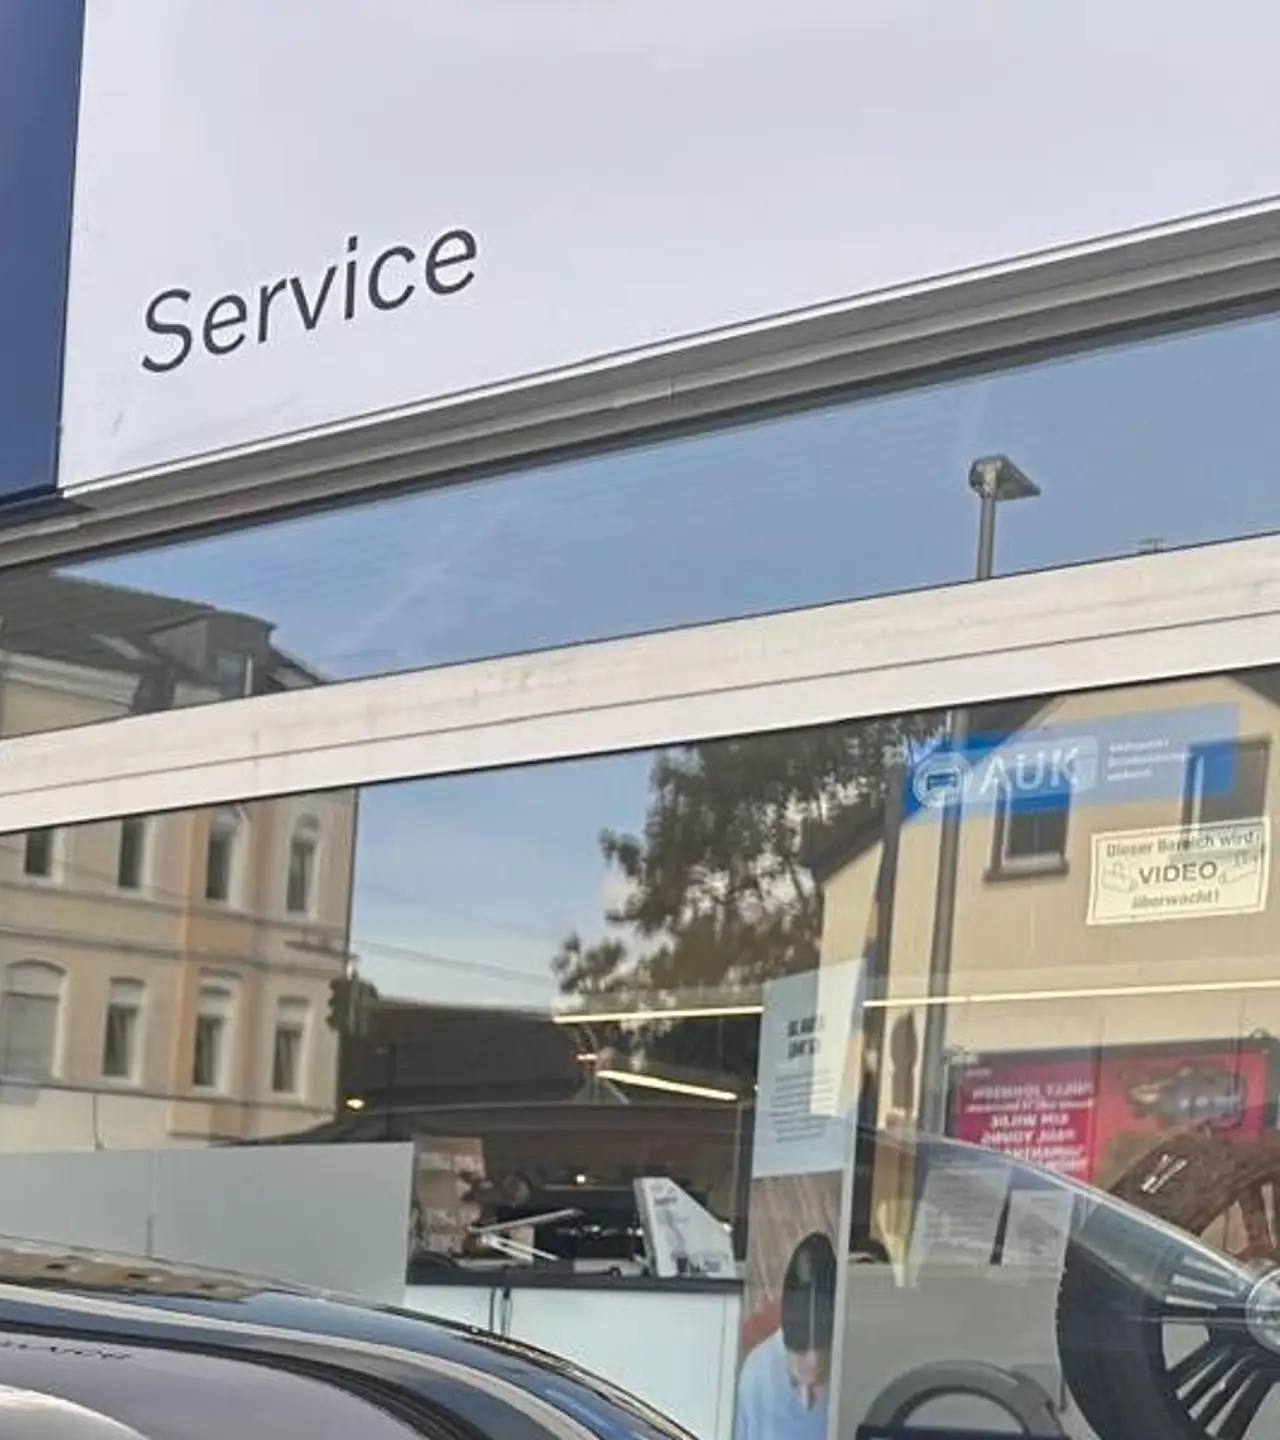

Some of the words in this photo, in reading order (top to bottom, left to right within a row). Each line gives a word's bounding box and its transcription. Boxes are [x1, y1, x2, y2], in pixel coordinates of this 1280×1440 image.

[140, 226, 478, 373] Service
[1106, 841, 1153, 858] Dieser
[1157, 834, 1214, 853] Bereich
[1219, 830, 1254, 848] wird
[1139, 861, 1218, 884] VIDEO
